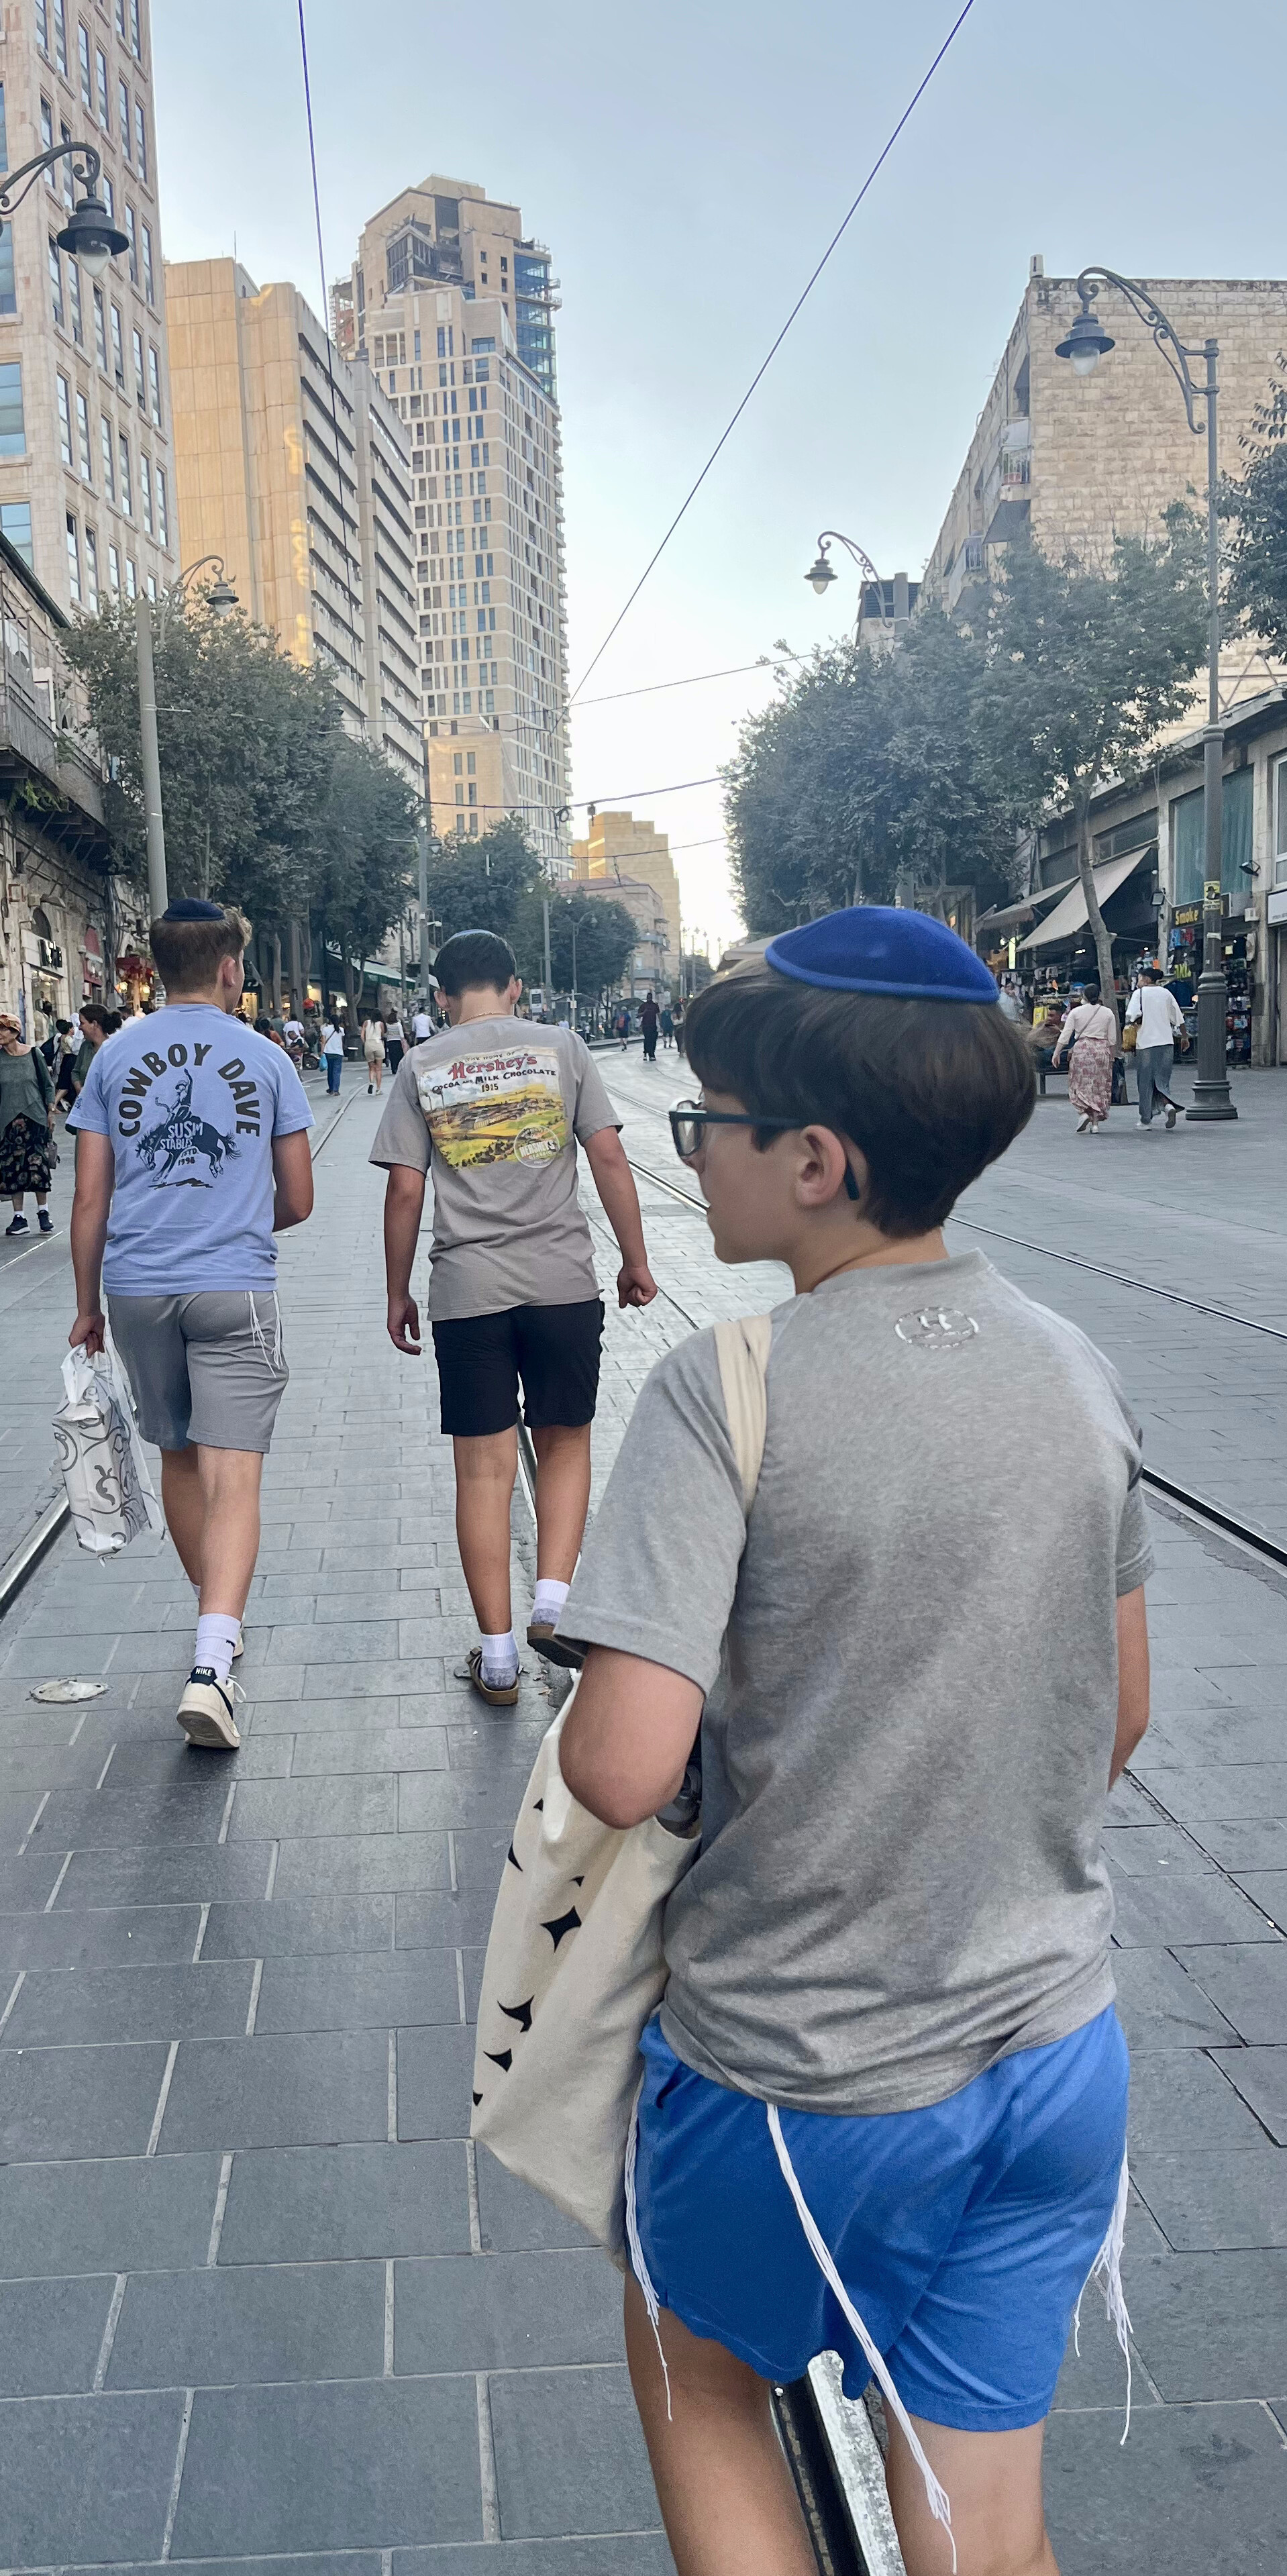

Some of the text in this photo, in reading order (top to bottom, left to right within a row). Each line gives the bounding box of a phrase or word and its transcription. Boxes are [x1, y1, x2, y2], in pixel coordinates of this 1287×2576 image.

[1175, 907, 1199, 925] Smoke
[448, 1053, 537, 1081] Hershey's
[503, 1069, 556, 1080] CHOCOLATE
[119, 1043, 261, 1137] COWBOY DAVE
[481, 1083, 499, 1092] 1915
[195, 1667, 213, 1677] NIKE
